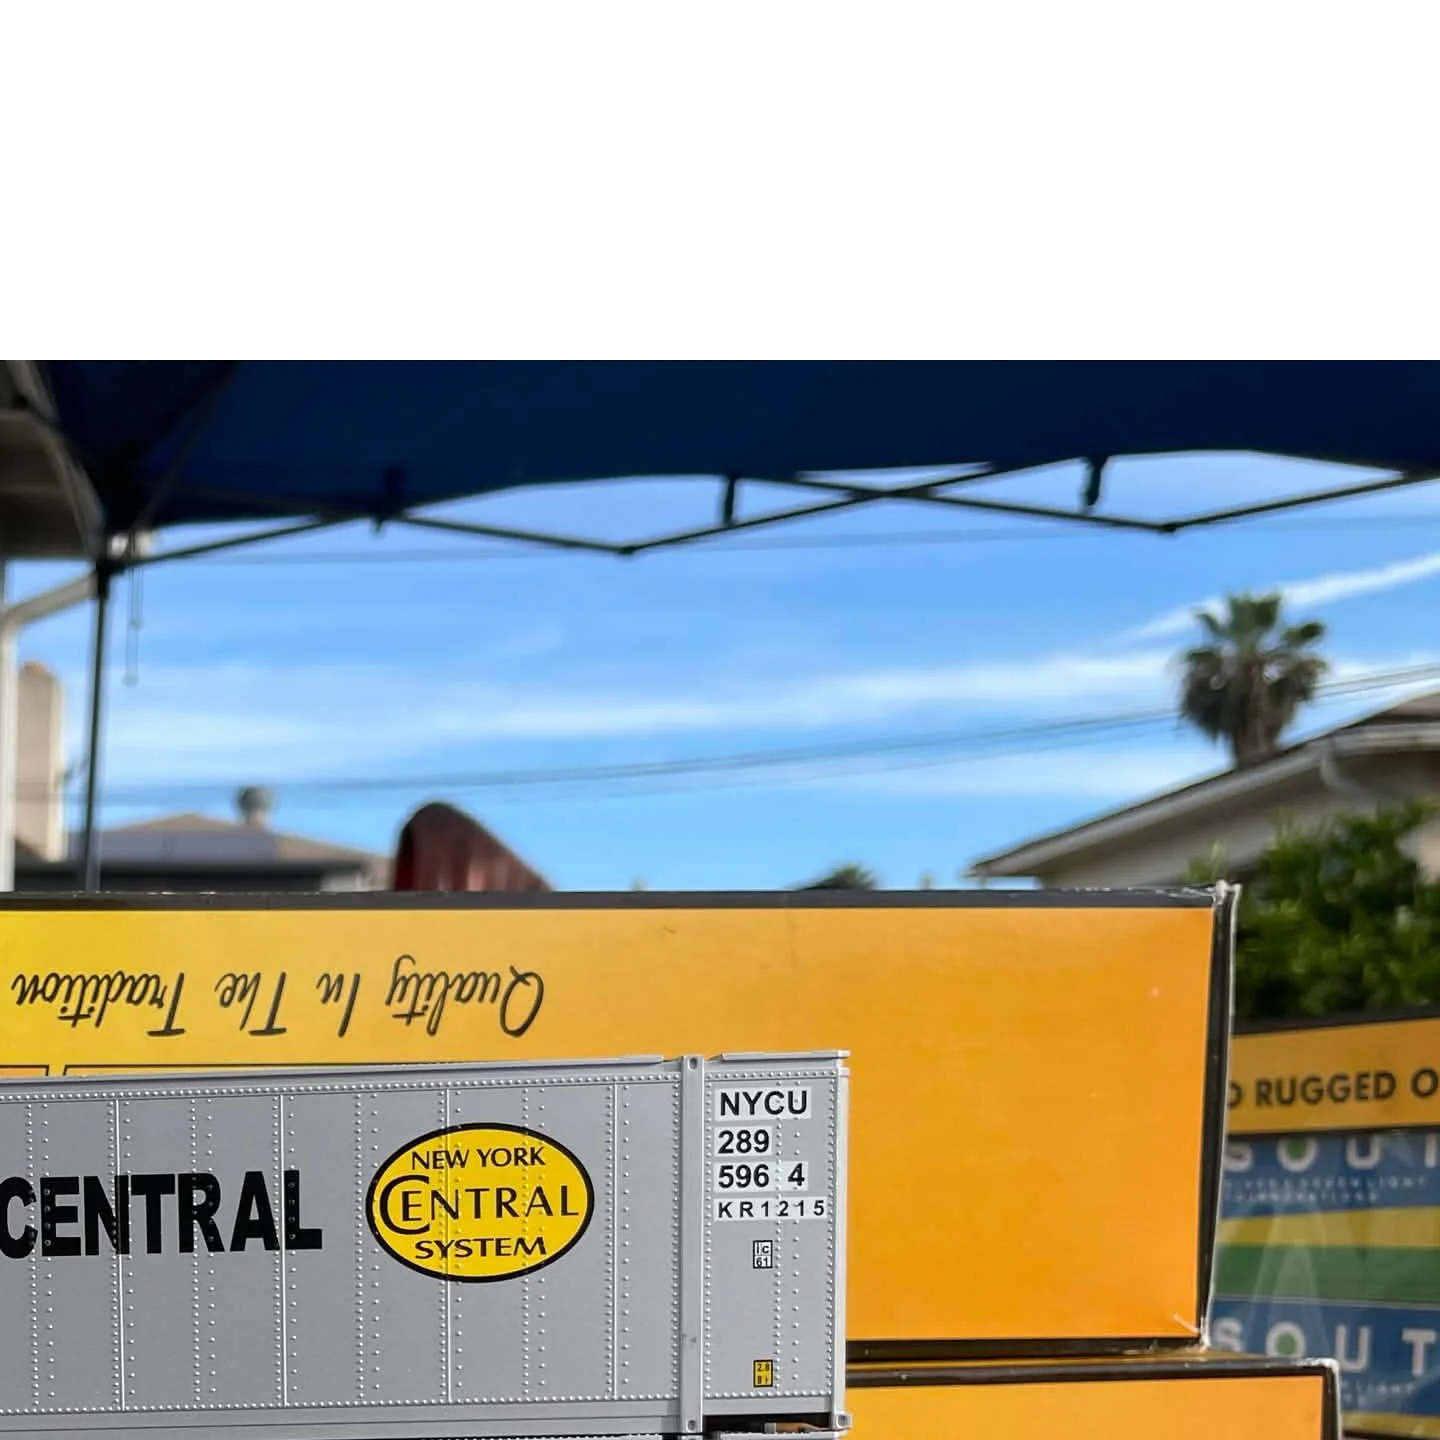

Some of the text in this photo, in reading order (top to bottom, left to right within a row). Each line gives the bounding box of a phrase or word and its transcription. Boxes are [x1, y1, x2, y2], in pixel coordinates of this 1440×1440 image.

[11, 971, 185, 1037] Tradition
[214, 971, 287, 1037] The
[316, 972, 361, 1038] In
[384, 954, 545, 1038] Quality
[720, 1090, 808, 1117] NYCU
[1255, 1070, 1397, 1107] RUGGED
[412, 1146, 546, 1170] NEW YORK
[718, 1129, 770, 1155] 289
[718, 1163, 805, 1188] 596 4
[379, 1174, 580, 1235] CENTRAL
[415, 1236, 547, 1260] SYSTEM
